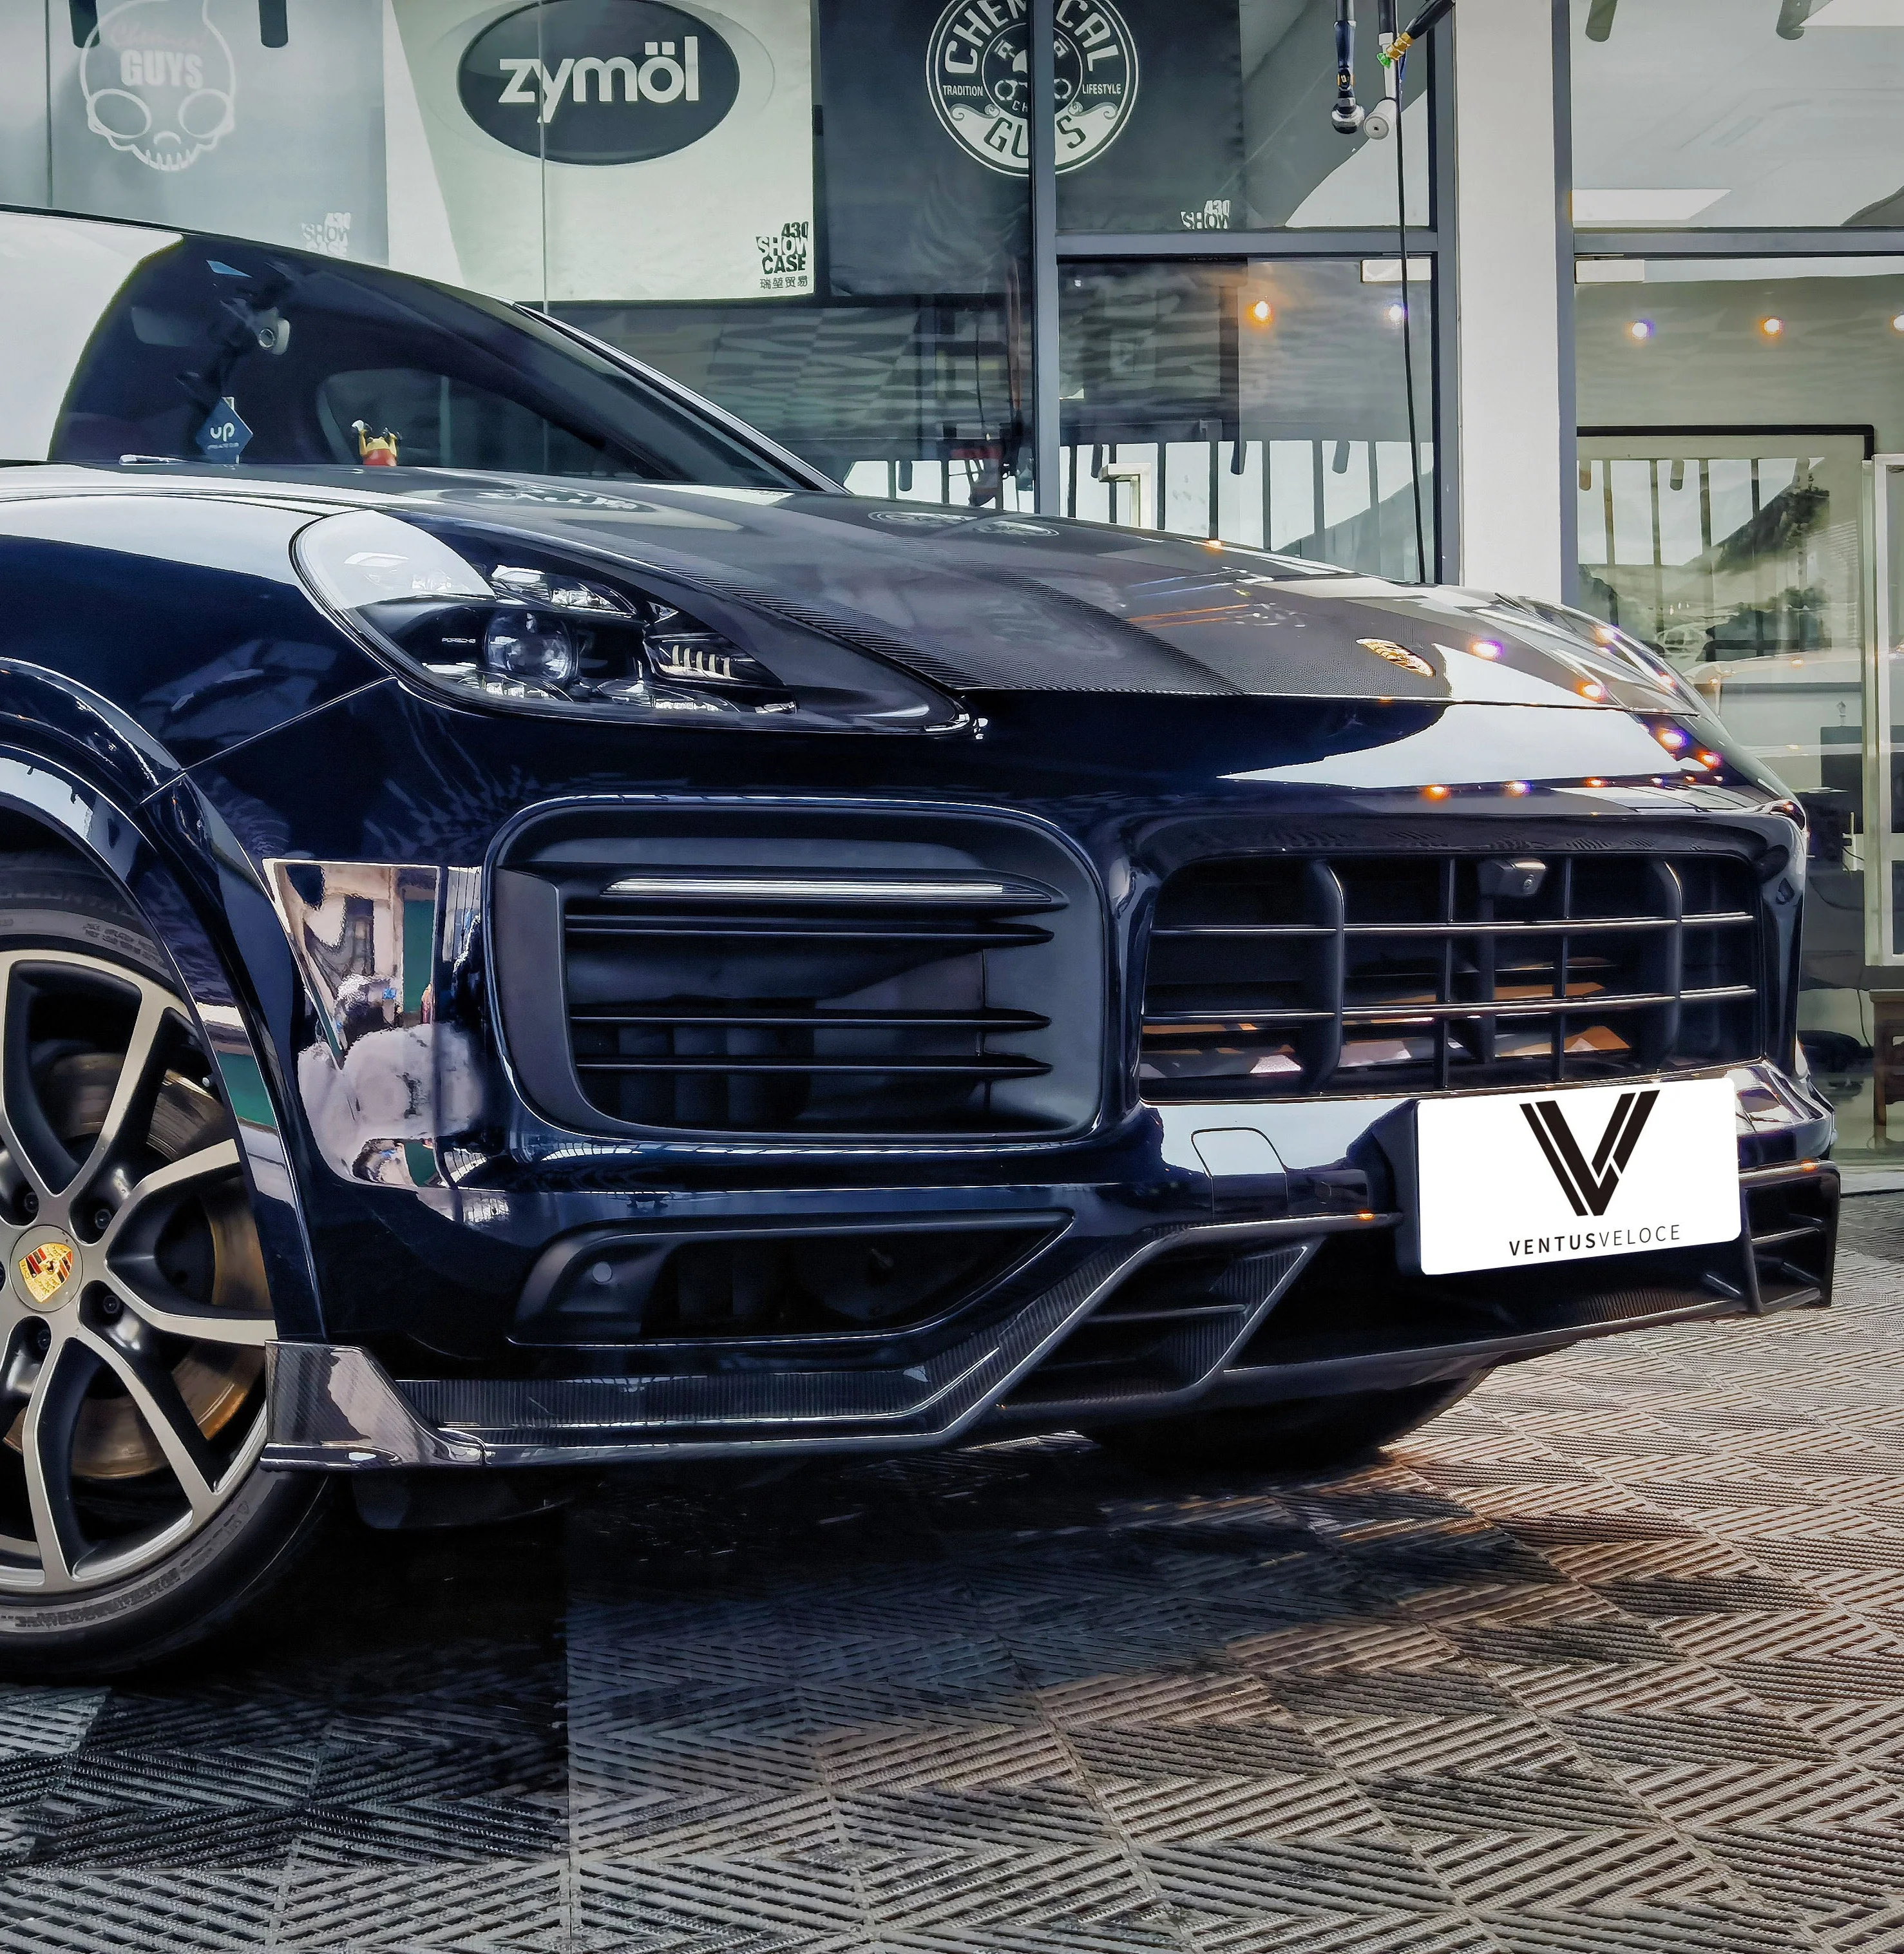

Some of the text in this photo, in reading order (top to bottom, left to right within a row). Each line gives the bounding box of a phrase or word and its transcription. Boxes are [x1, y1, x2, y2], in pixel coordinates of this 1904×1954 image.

[120, 50, 204, 90] GUYS
[498, 36, 700, 123] zymöl
[942, 84, 984, 97] TRADITION
[1082, 83, 1121, 95] LIFESTYLE
[983, 115, 1087, 159] GUS
[1203, 200, 1230, 217] 430
[781, 221, 809, 238] 430
[1180, 211, 1229, 230] SHOW
[756, 236, 808, 256] SHOW
[761, 254, 806, 274] CASE
